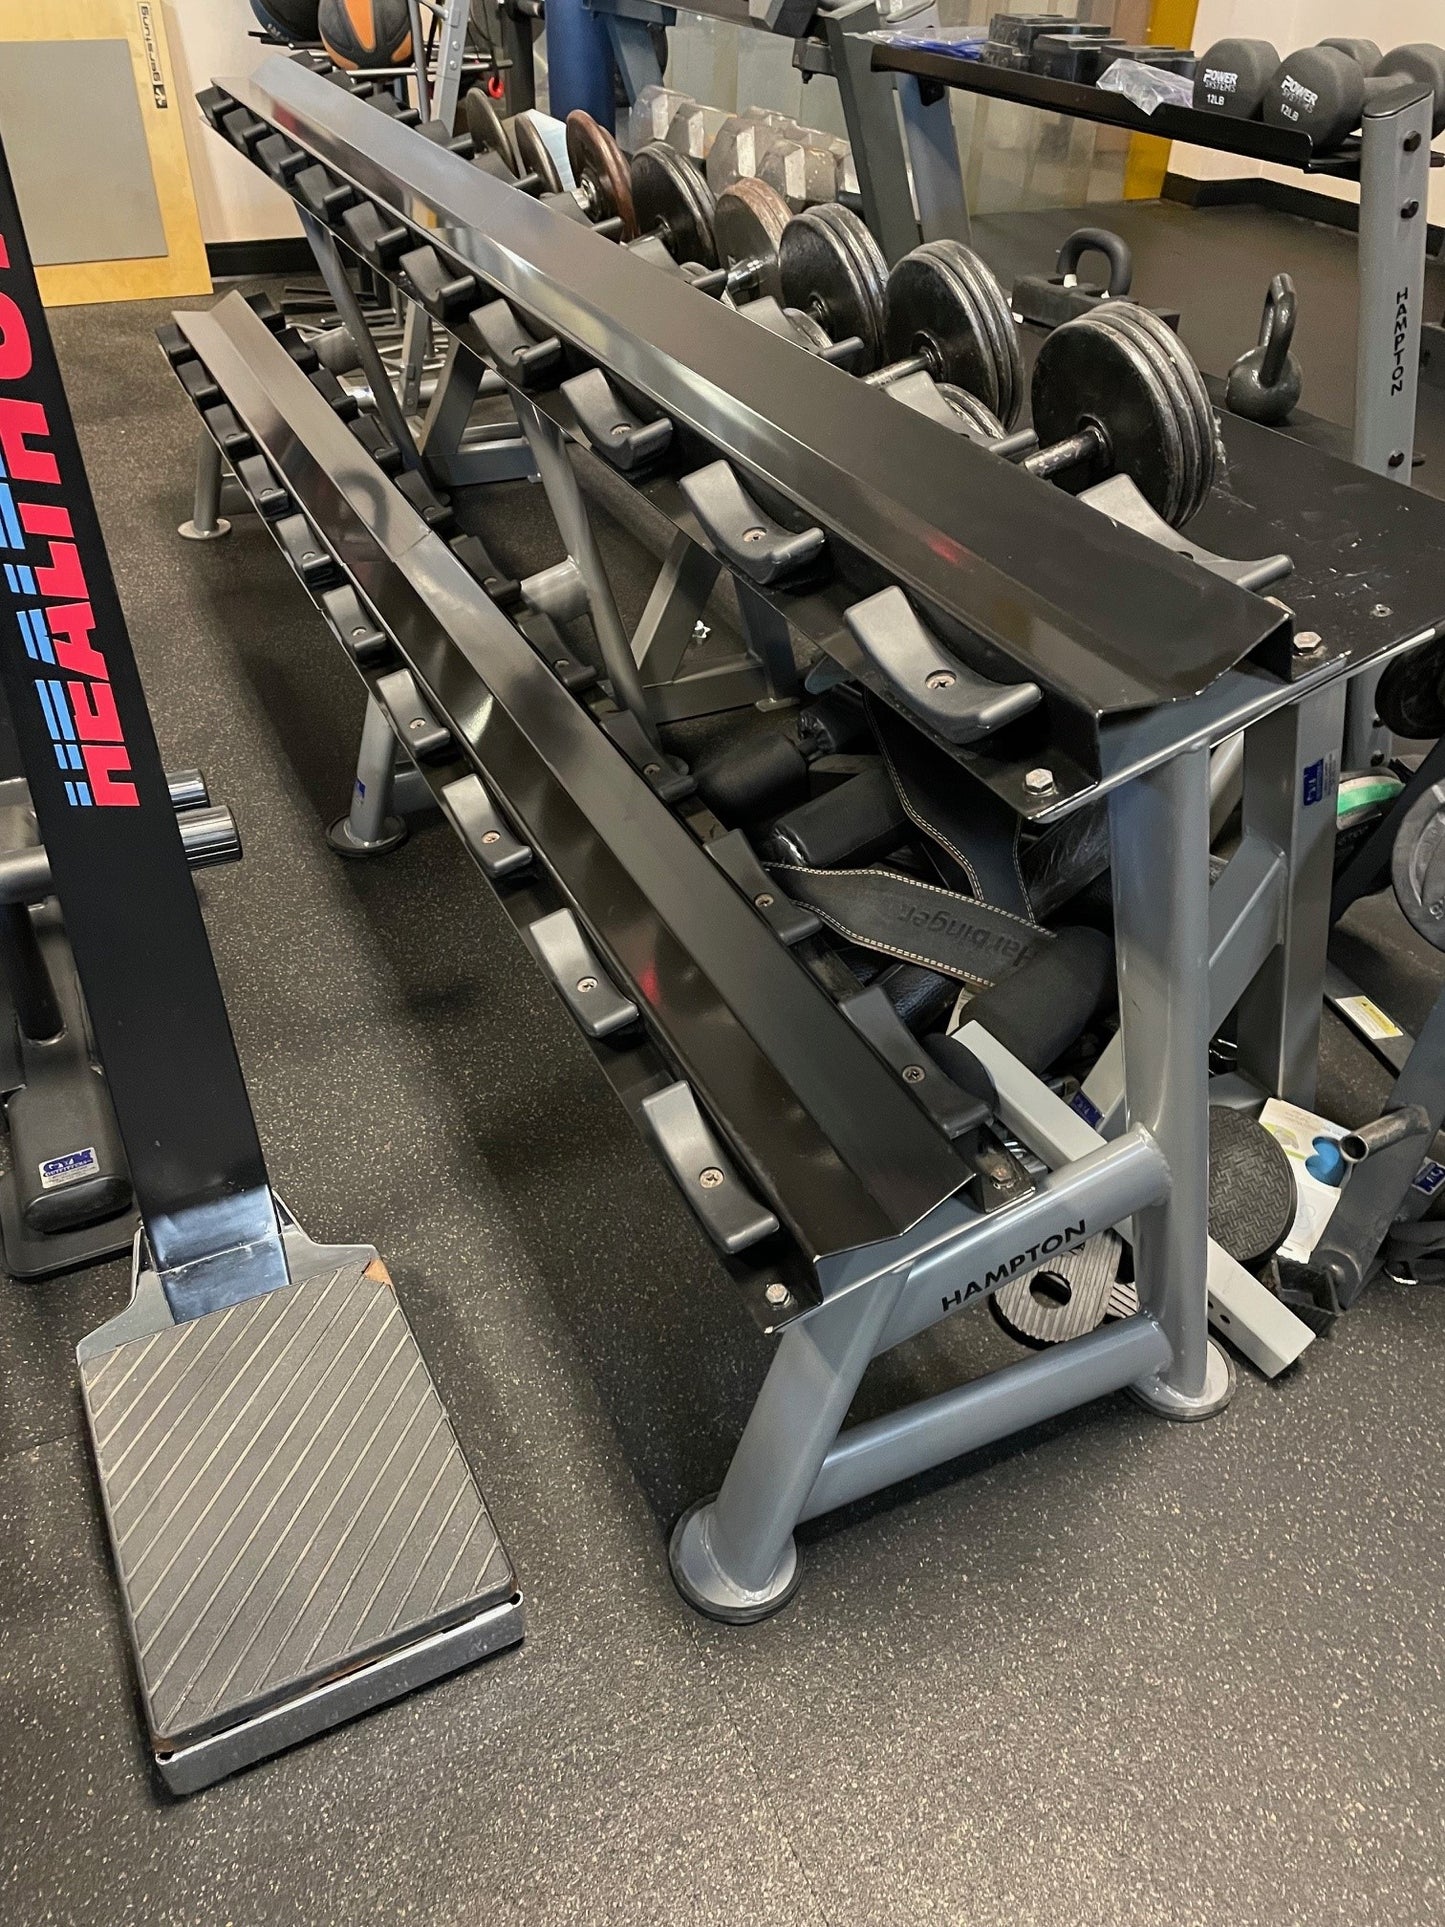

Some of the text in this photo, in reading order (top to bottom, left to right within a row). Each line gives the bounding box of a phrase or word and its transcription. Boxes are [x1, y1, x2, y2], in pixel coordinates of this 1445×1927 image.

[1203, 68, 1238, 85] POWER
[1205, 80, 1236, 93] SYSTEMS
[1281, 74, 1318, 105] POWER
[1207, 93, 1225, 106] 12LB
[1281, 103, 1299, 121] 12LB
[1391, 286, 1408, 397] HAMPTON
[941, 1219, 1087, 1312] HAMPTON
